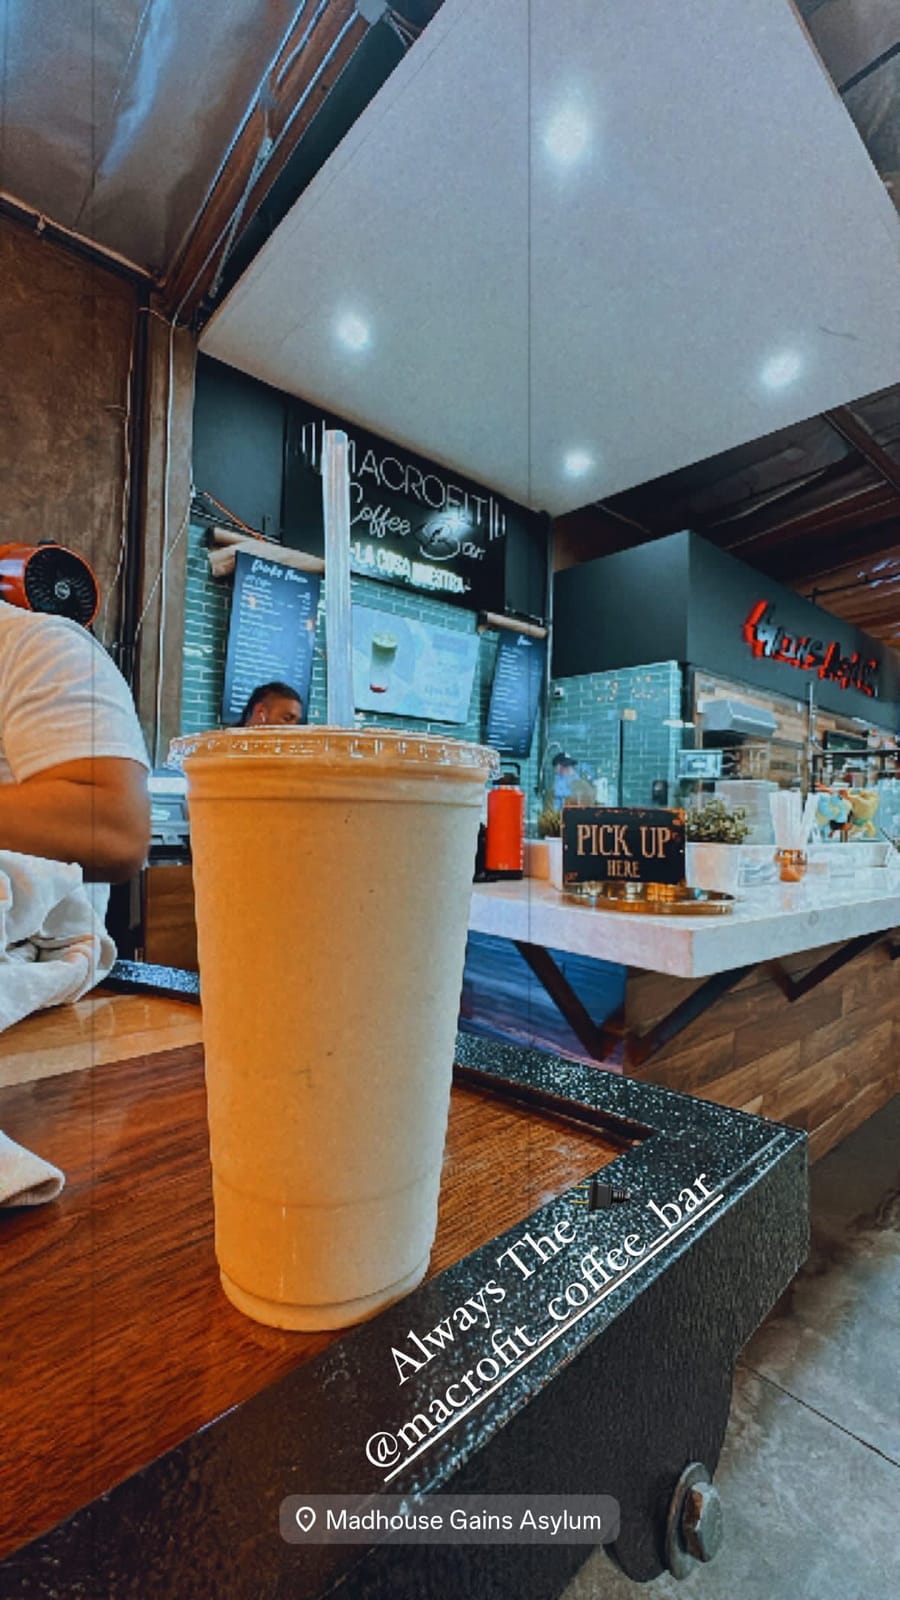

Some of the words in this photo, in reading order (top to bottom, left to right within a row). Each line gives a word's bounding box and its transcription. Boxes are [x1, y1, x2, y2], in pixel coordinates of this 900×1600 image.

[576, 824, 633, 857] PICK
[640, 826, 671, 858] UP
[607, 860, 641, 878] HERE
